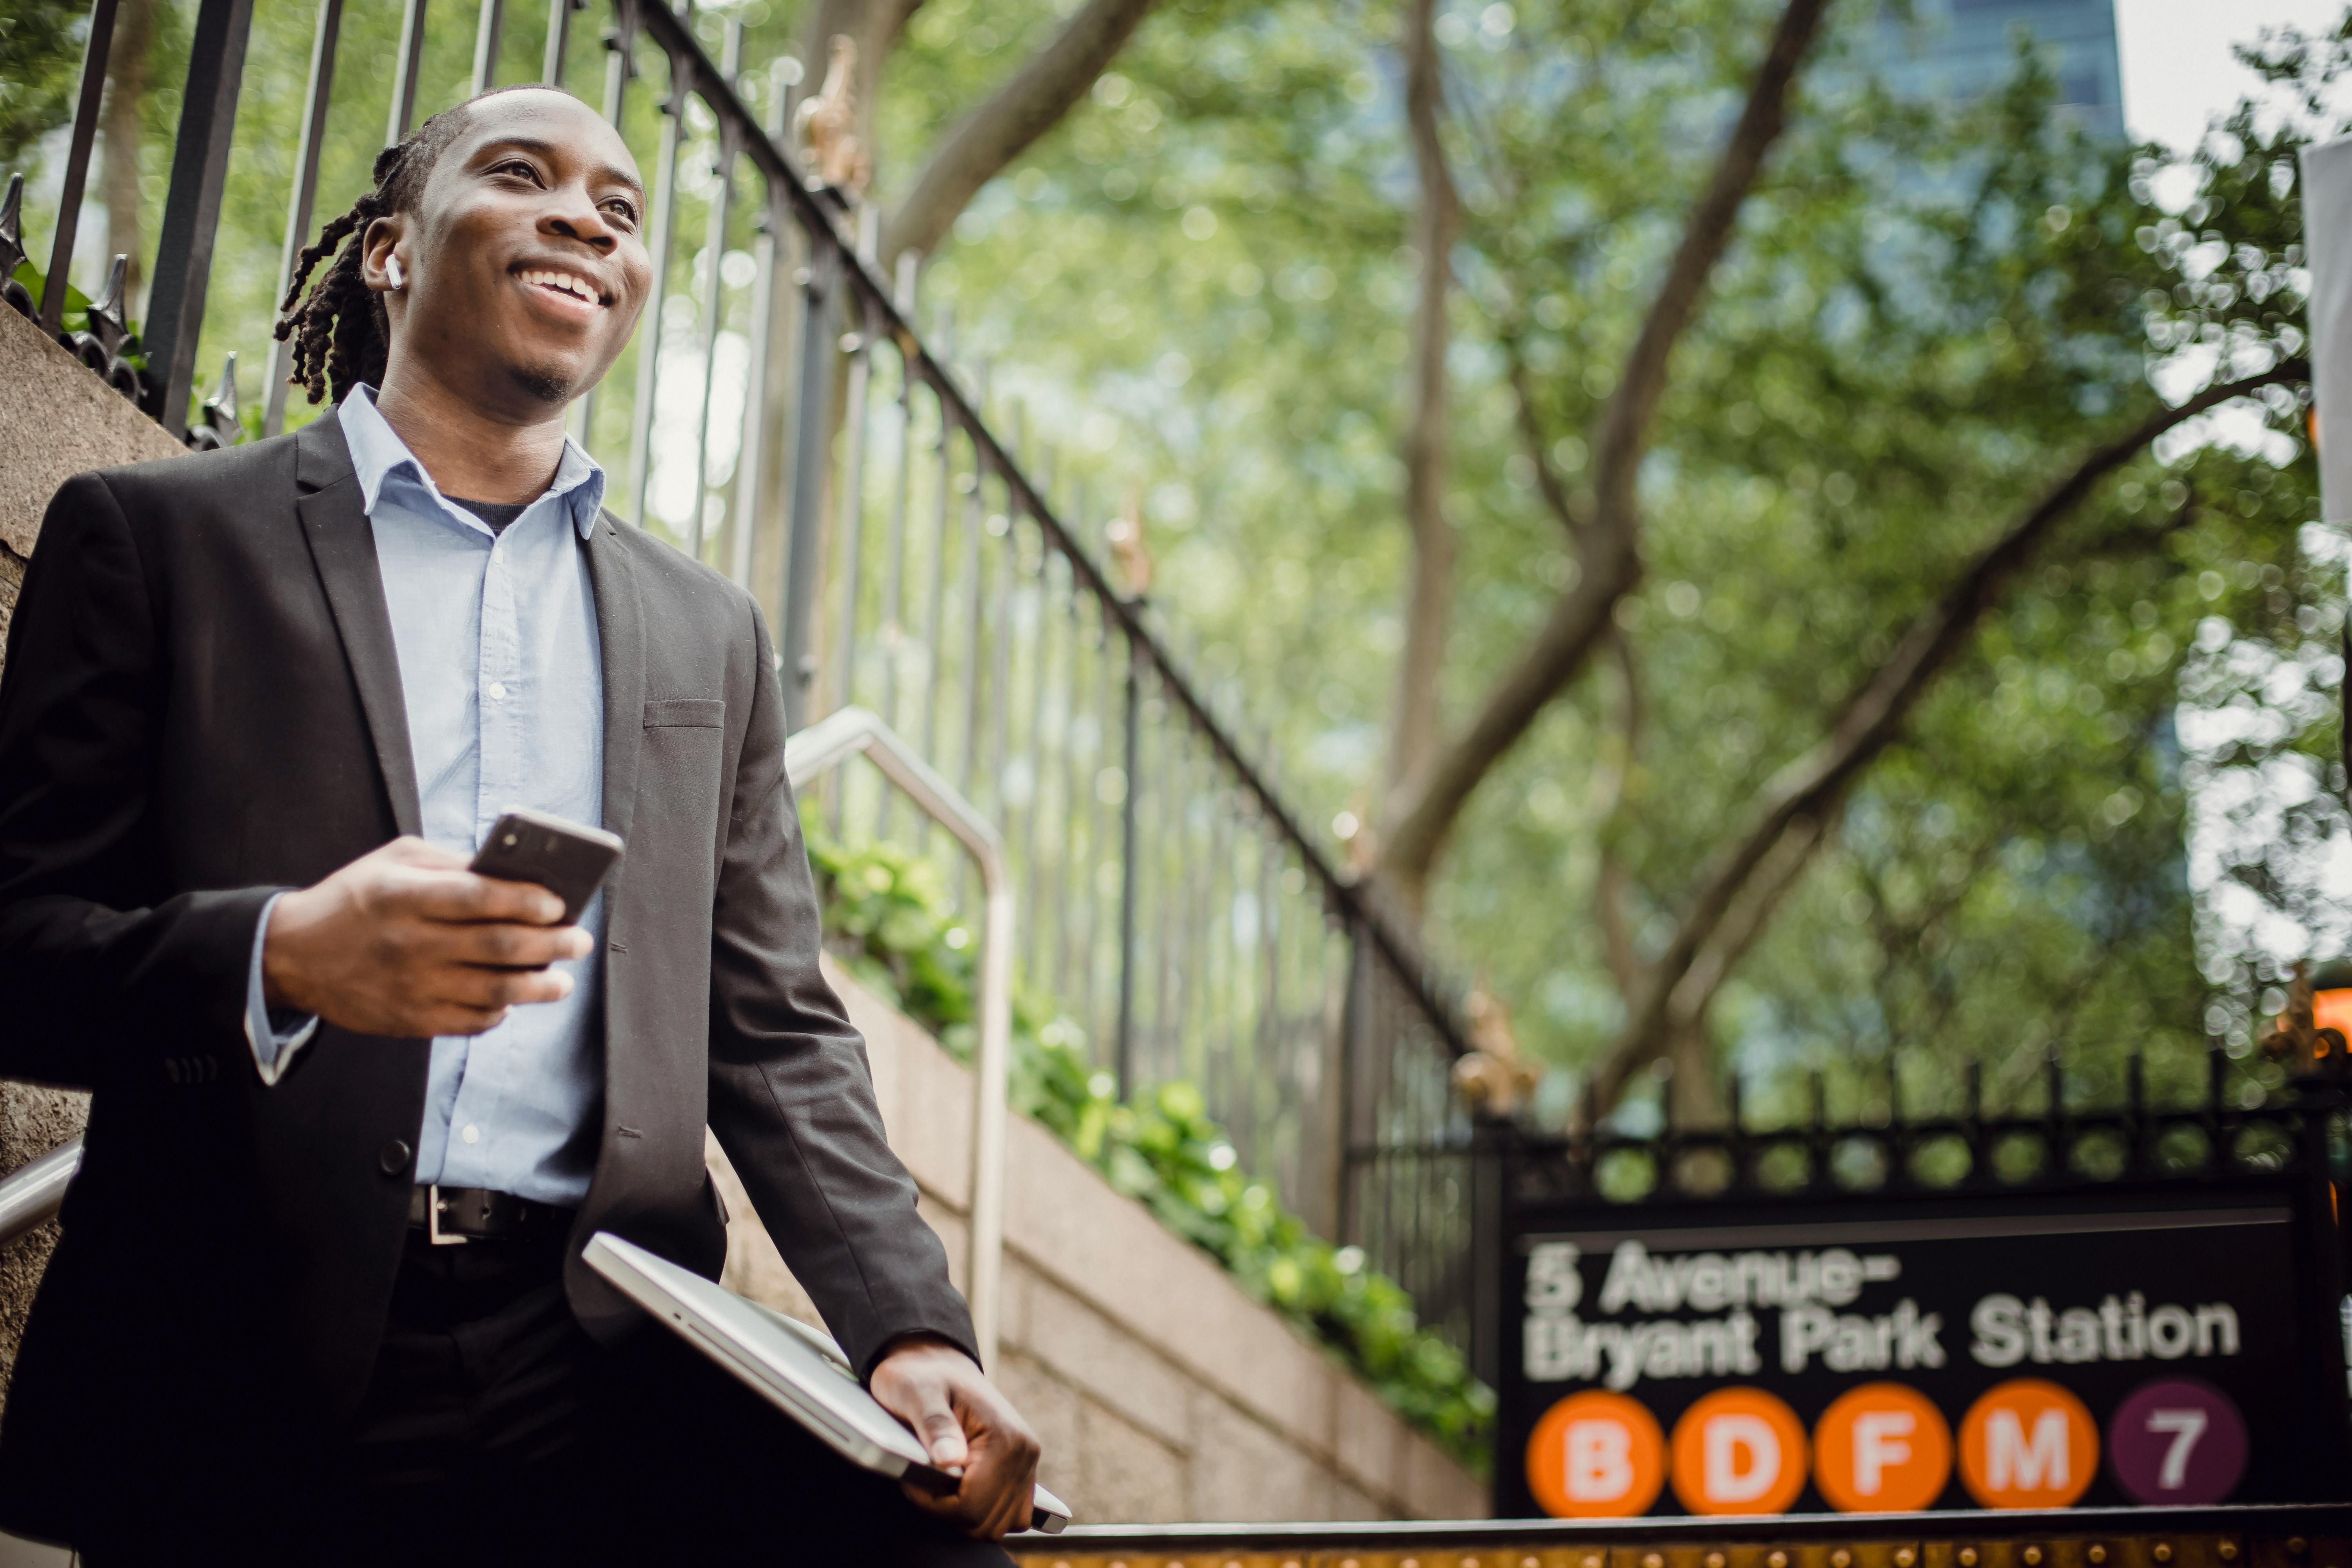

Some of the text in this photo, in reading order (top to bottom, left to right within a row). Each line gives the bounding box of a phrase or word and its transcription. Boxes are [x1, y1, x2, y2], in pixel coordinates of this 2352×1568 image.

[1526, 1241, 1582, 1312] 5
[1524, 1291, 2239, 1390] Bryant Park Station
[1565, 1408, 2208, 1503] B D F M 7
